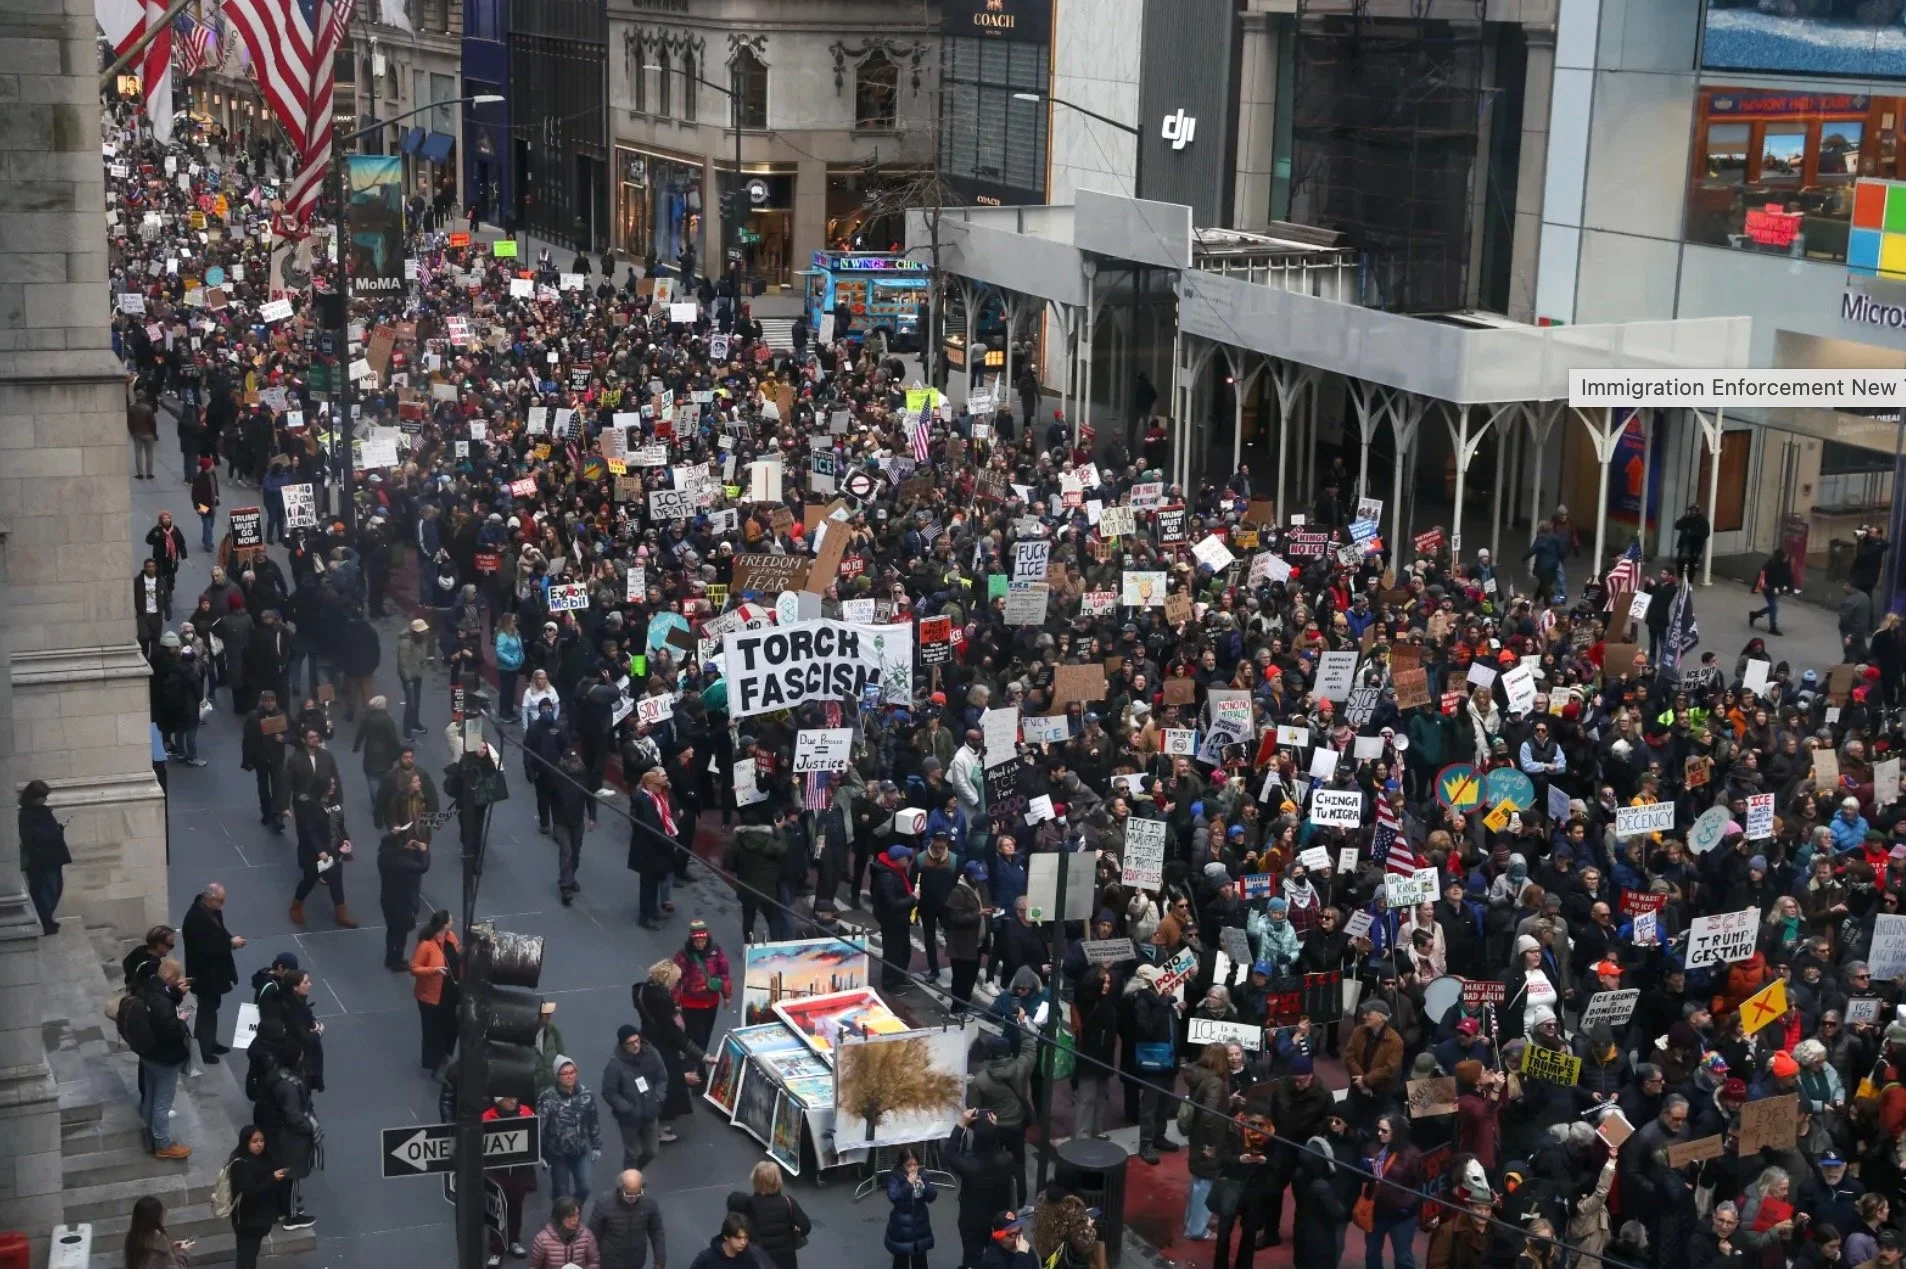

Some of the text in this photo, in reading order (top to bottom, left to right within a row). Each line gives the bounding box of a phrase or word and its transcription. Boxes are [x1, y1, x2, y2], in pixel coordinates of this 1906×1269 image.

[974, 13, 1015, 28] COACH
[977, 195, 1001, 206] COACH
[851, 258, 885, 269] WINGS
[355, 277, 401, 291] MoMA
[814, 458, 832, 472] ICE
[654, 492, 689, 507] ICE
[653, 503, 694, 517] DEATH
[1103, 509, 1115, 520] WE
[230, 513, 260, 523] TRUMP
[1161, 518, 1182, 527] MUST
[234, 521, 257, 530] MUST
[237, 536, 259, 545] NOW!
[1163, 533, 1183, 541] NOW!
[1299, 534, 1327, 542] KINGS
[1019, 544, 1046, 560] FUCK
[1291, 544, 1324, 553] NO ICE
[739, 557, 802, 569] FREEDOM
[841, 560, 864, 571] NO ICE!
[1017, 560, 1044, 576] ICE
[744, 575, 789, 592] FEAR
[551, 597, 587, 609] Mobil
[684, 602, 695, 611] NO
[1093, 599, 1105, 608] UP
[1102, 607, 1116, 615] ICE
[746, 621, 761, 630] NO
[737, 627, 859, 670] TORCH
[1687, 668, 1716, 678] ICE OUT
[740, 661, 881, 711] FASCISM
[1350, 688, 1379, 706] STOP
[640, 702, 659, 719] STOP
[1022, 717, 1051, 727] FUCK
[1038, 728, 1061, 740] ICE
[1691, 772, 1706, 783] ICE
[1316, 792, 1358, 806] CHINGA
[1751, 795, 1771, 806] ICE
[1329, 808, 1360, 821] MIGRA
[1129, 818, 1161, 834] ICE IS
[1618, 812, 1673, 831] DECENCY
[1396, 883, 1416, 892] KING
[1706, 911, 1746, 932] ICE
[1692, 943, 1752, 963] GESTAPO
[1163, 955, 1181, 973] NO
[1464, 983, 1505, 992] MAKE LYING
[1463, 992, 1505, 1001] BAD AGAIN
[1592, 991, 1639, 1003] ICE AGENTS
[1589, 1005, 1631, 1016] DOMESTIC
[1192, 1020, 1215, 1040] ICE
[1530, 1044, 1574, 1068] ICE IS
[1528, 1056, 1574, 1077] TRUMP'S
[1526, 1067, 1571, 1085] GESTAPO
[408, 1133, 519, 1160] ONE AY
